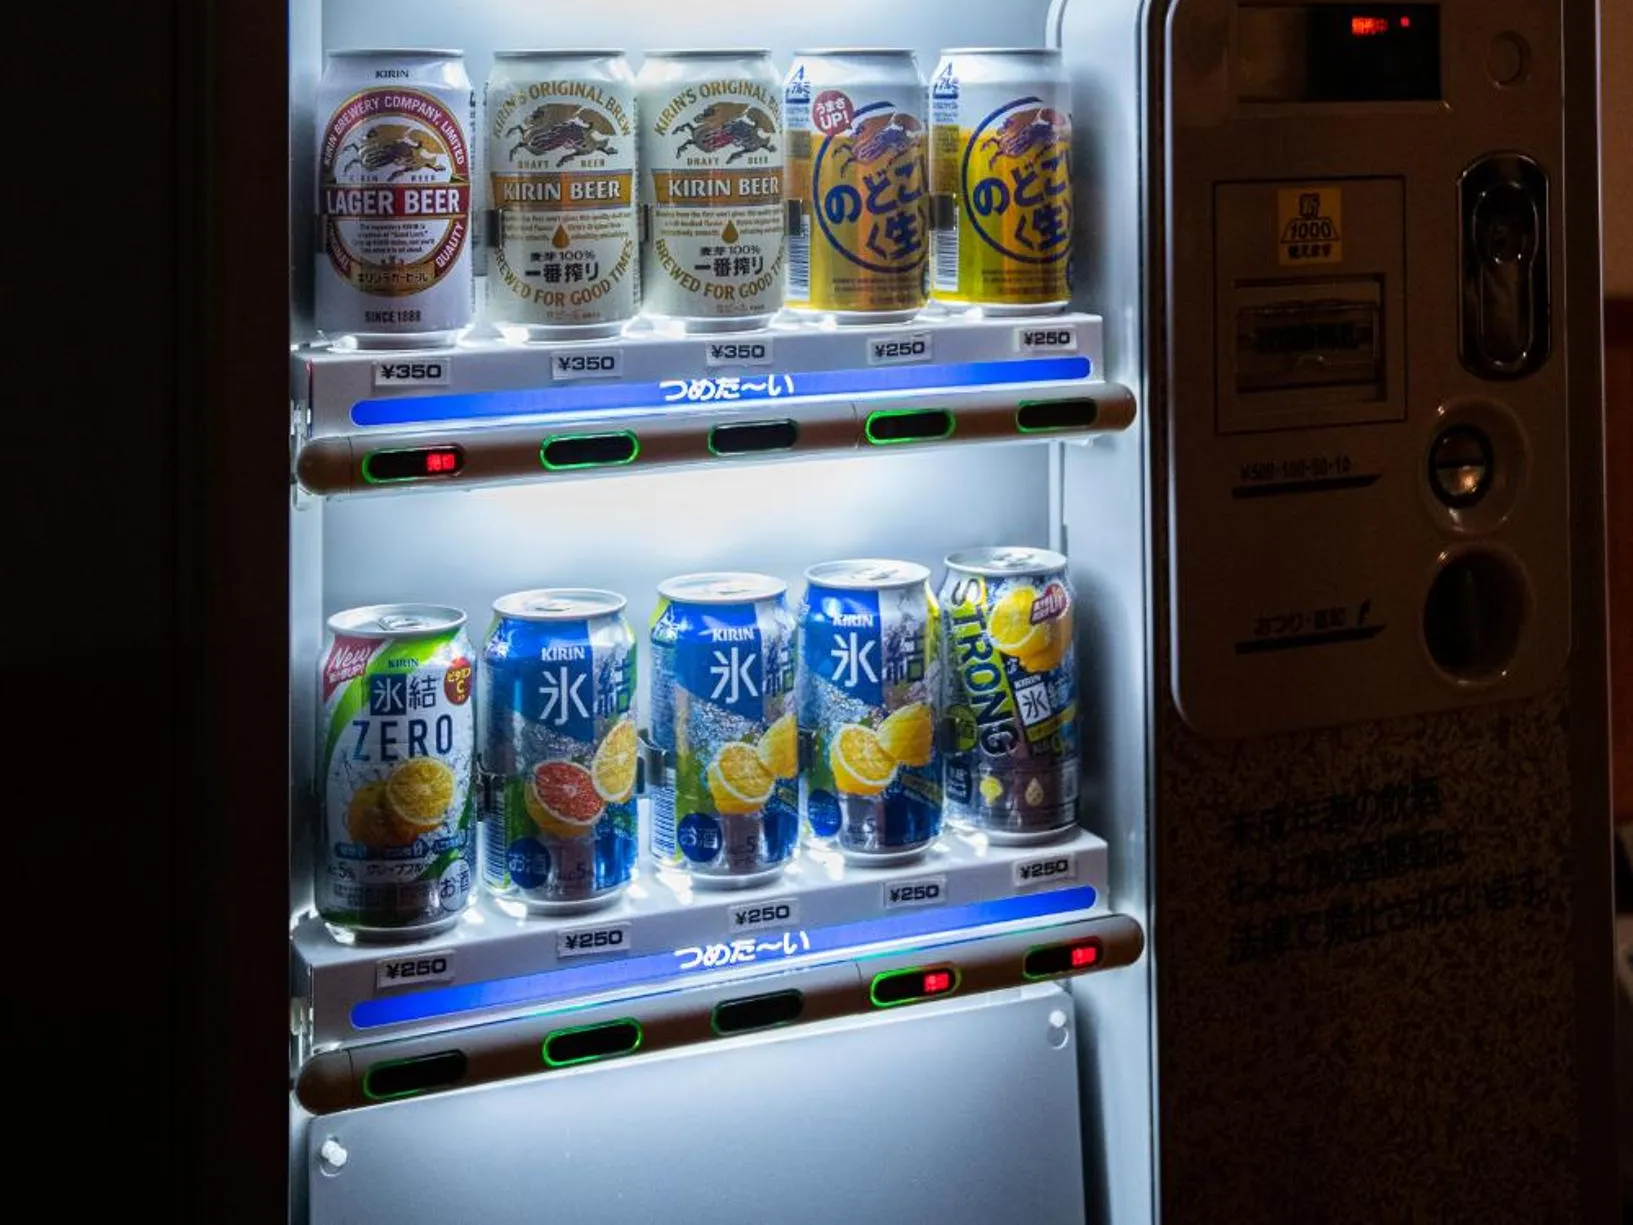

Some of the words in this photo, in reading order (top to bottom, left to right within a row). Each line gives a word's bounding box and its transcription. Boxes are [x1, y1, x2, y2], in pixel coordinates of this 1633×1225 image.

[375, 70, 409, 79] KIRIN
[528, 80, 604, 104] ORIGINAL
[605, 96, 632, 137] BREW
[654, 88, 697, 137] KIRIN'S
[700, 79, 770, 106] ORIGINAL
[821, 111, 850, 130] UP!
[336, 98, 380, 135] BREWERY
[441, 121, 465, 165] LIMITED
[504, 182, 561, 201] KIRIN
[571, 180, 621, 199] BEER
[668, 179, 731, 198] KIRIN
[739, 177, 779, 196] BEER
[326, 189, 395, 215] LAGER
[404, 189, 460, 214] BEER
[1290, 222, 1332, 239] 1000
[436, 222, 464, 268] QUALITY
[525, 262, 599, 284] 一番搾り
[656, 238, 701, 293] BREWED
[703, 283, 734, 300] FOR
[739, 274, 774, 299] GOOD
[694, 257, 764, 277] 一番搾り
[534, 289, 565, 307] FOR
[570, 279, 611, 306] GOOD
[365, 311, 395, 323] SINCE
[1024, 330, 1071, 346] ¥250
[711, 344, 765, 360] ¥350
[875, 341, 925, 357] ¥250
[381, 363, 442, 380] ¥350
[557, 355, 615, 372] ¥350
[832, 613, 874, 627] KIRIN
[712, 627, 755, 642] KIRIN
[388, 657, 419, 669] KIRIN
[541, 647, 585, 661] KIRIN
[951, 577, 1019, 755] STRONG
[373, 674, 437, 713] 氷結
[352, 714, 453, 762] ZERO
[1019, 860, 1069, 879] ¥250
[889, 883, 940, 902] ¥250
[734, 905, 791, 925] ¥250
[565, 929, 624, 950] ¥250
[385, 958, 448, 979] ¥250
